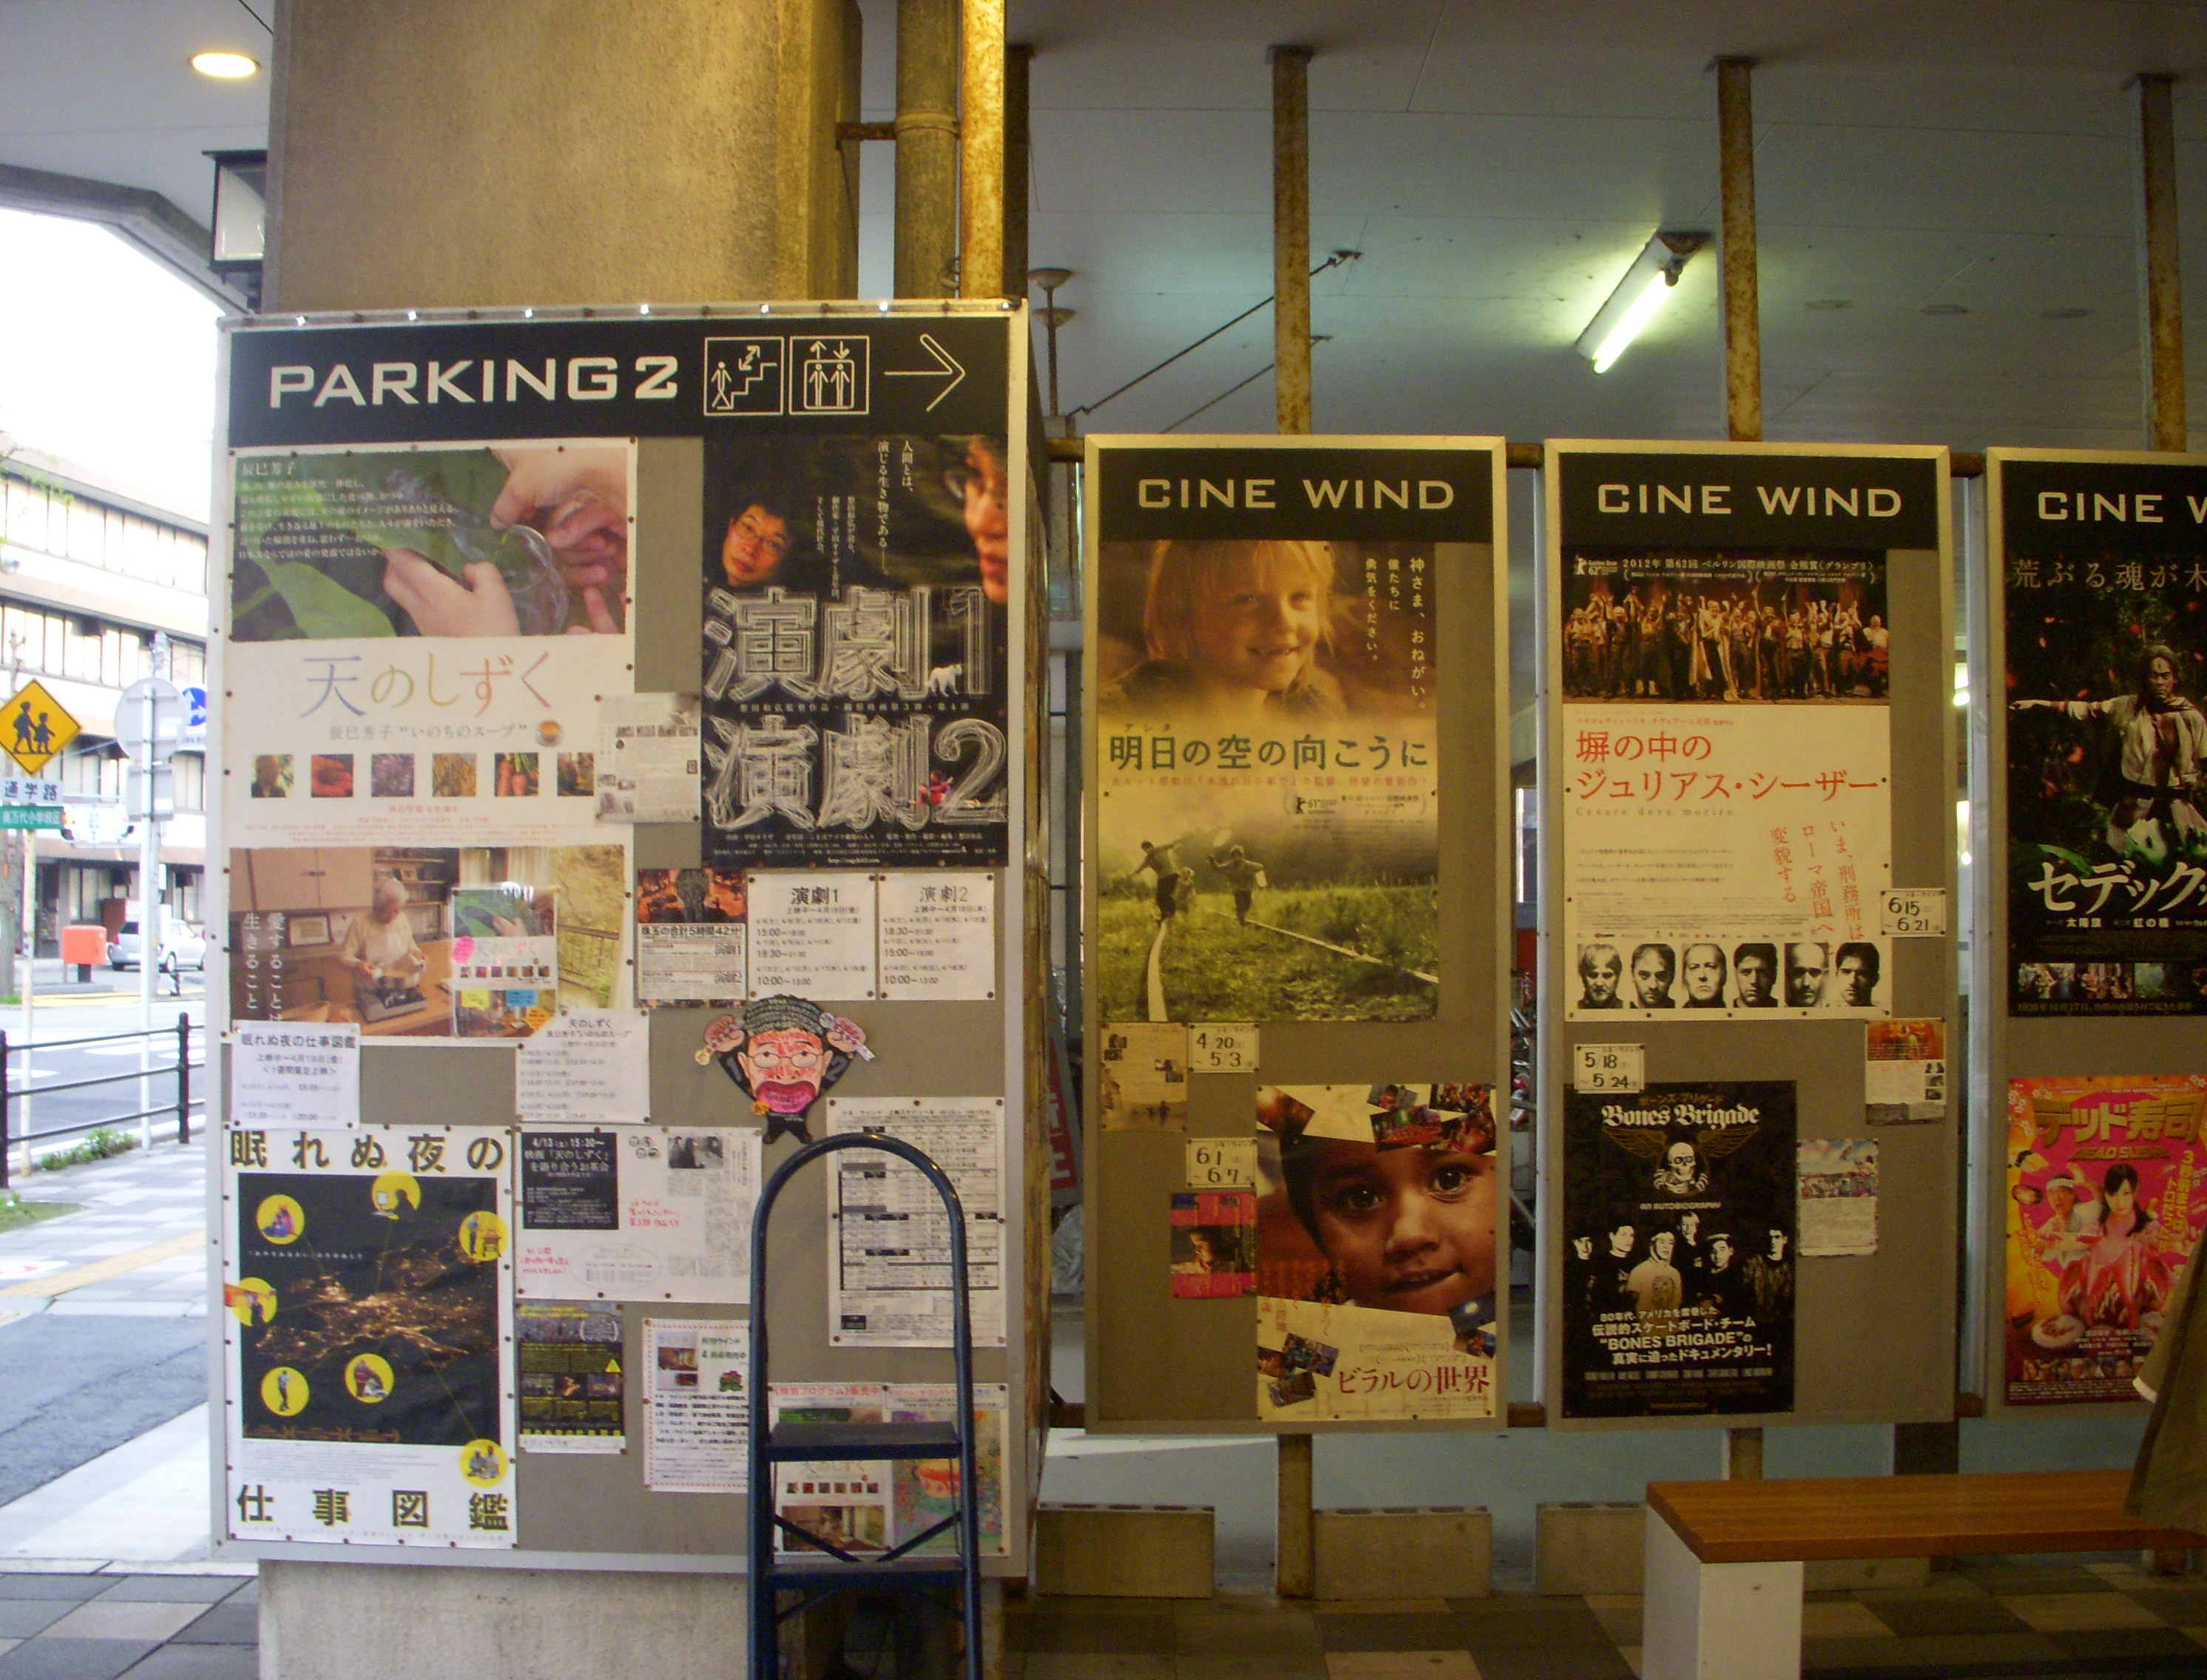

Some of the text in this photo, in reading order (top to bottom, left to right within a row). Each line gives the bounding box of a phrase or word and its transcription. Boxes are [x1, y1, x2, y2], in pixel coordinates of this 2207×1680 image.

[270, 356, 617, 407] PARKING
[1138, 478, 1455, 510] CINE WIND
[1598, 484, 1902, 517] CINE WIND
[2038, 492, 2163, 523] CINE
[1409, 557, 1426, 709] 神さま、おねがい。
[299, 651, 552, 719] 天のしずく
[1109, 734, 1427, 770] 明日の空の向こうに
[1576, 731, 1712, 763] 塀の中の
[4, 781, 58, 801] 通学路
[1577, 769, 1879, 802] ジュリアス・シーザー
[1576, 806, 1734, 816] Cesare deve morire
[919, 885, 968, 903] 演劇2
[1830, 820, 1865, 941] いま、刑務所は
[2027, 860, 2207, 915] セデック・
[791, 887, 838, 905] 演劇1
[1888, 897, 1920, 916] 6 15
[1897, 917, 1930, 932] 6 21
[241, 1034, 356, 1049] 眠れぬ夜の仕事図鑑
[1197, 1032, 1234, 1049] 4 20
[1210, 1051, 1242, 1067] 5 3
[1584, 1051, 1618, 1069] 5 18
[1592, 1073, 1629, 1088] 5 24
[1601, 1104, 1760, 1129] Bones Brigade
[2032, 1093, 2206, 1149] デッド寿司
[230, 1130, 504, 1173] 眠れぬ夜の
[1196, 1146, 1210, 1165] 6
[1207, 1167, 1221, 1183] 6
[1338, 1365, 1490, 1395] ビラルの世界
[237, 1483, 510, 1532] 仕事図鑑
